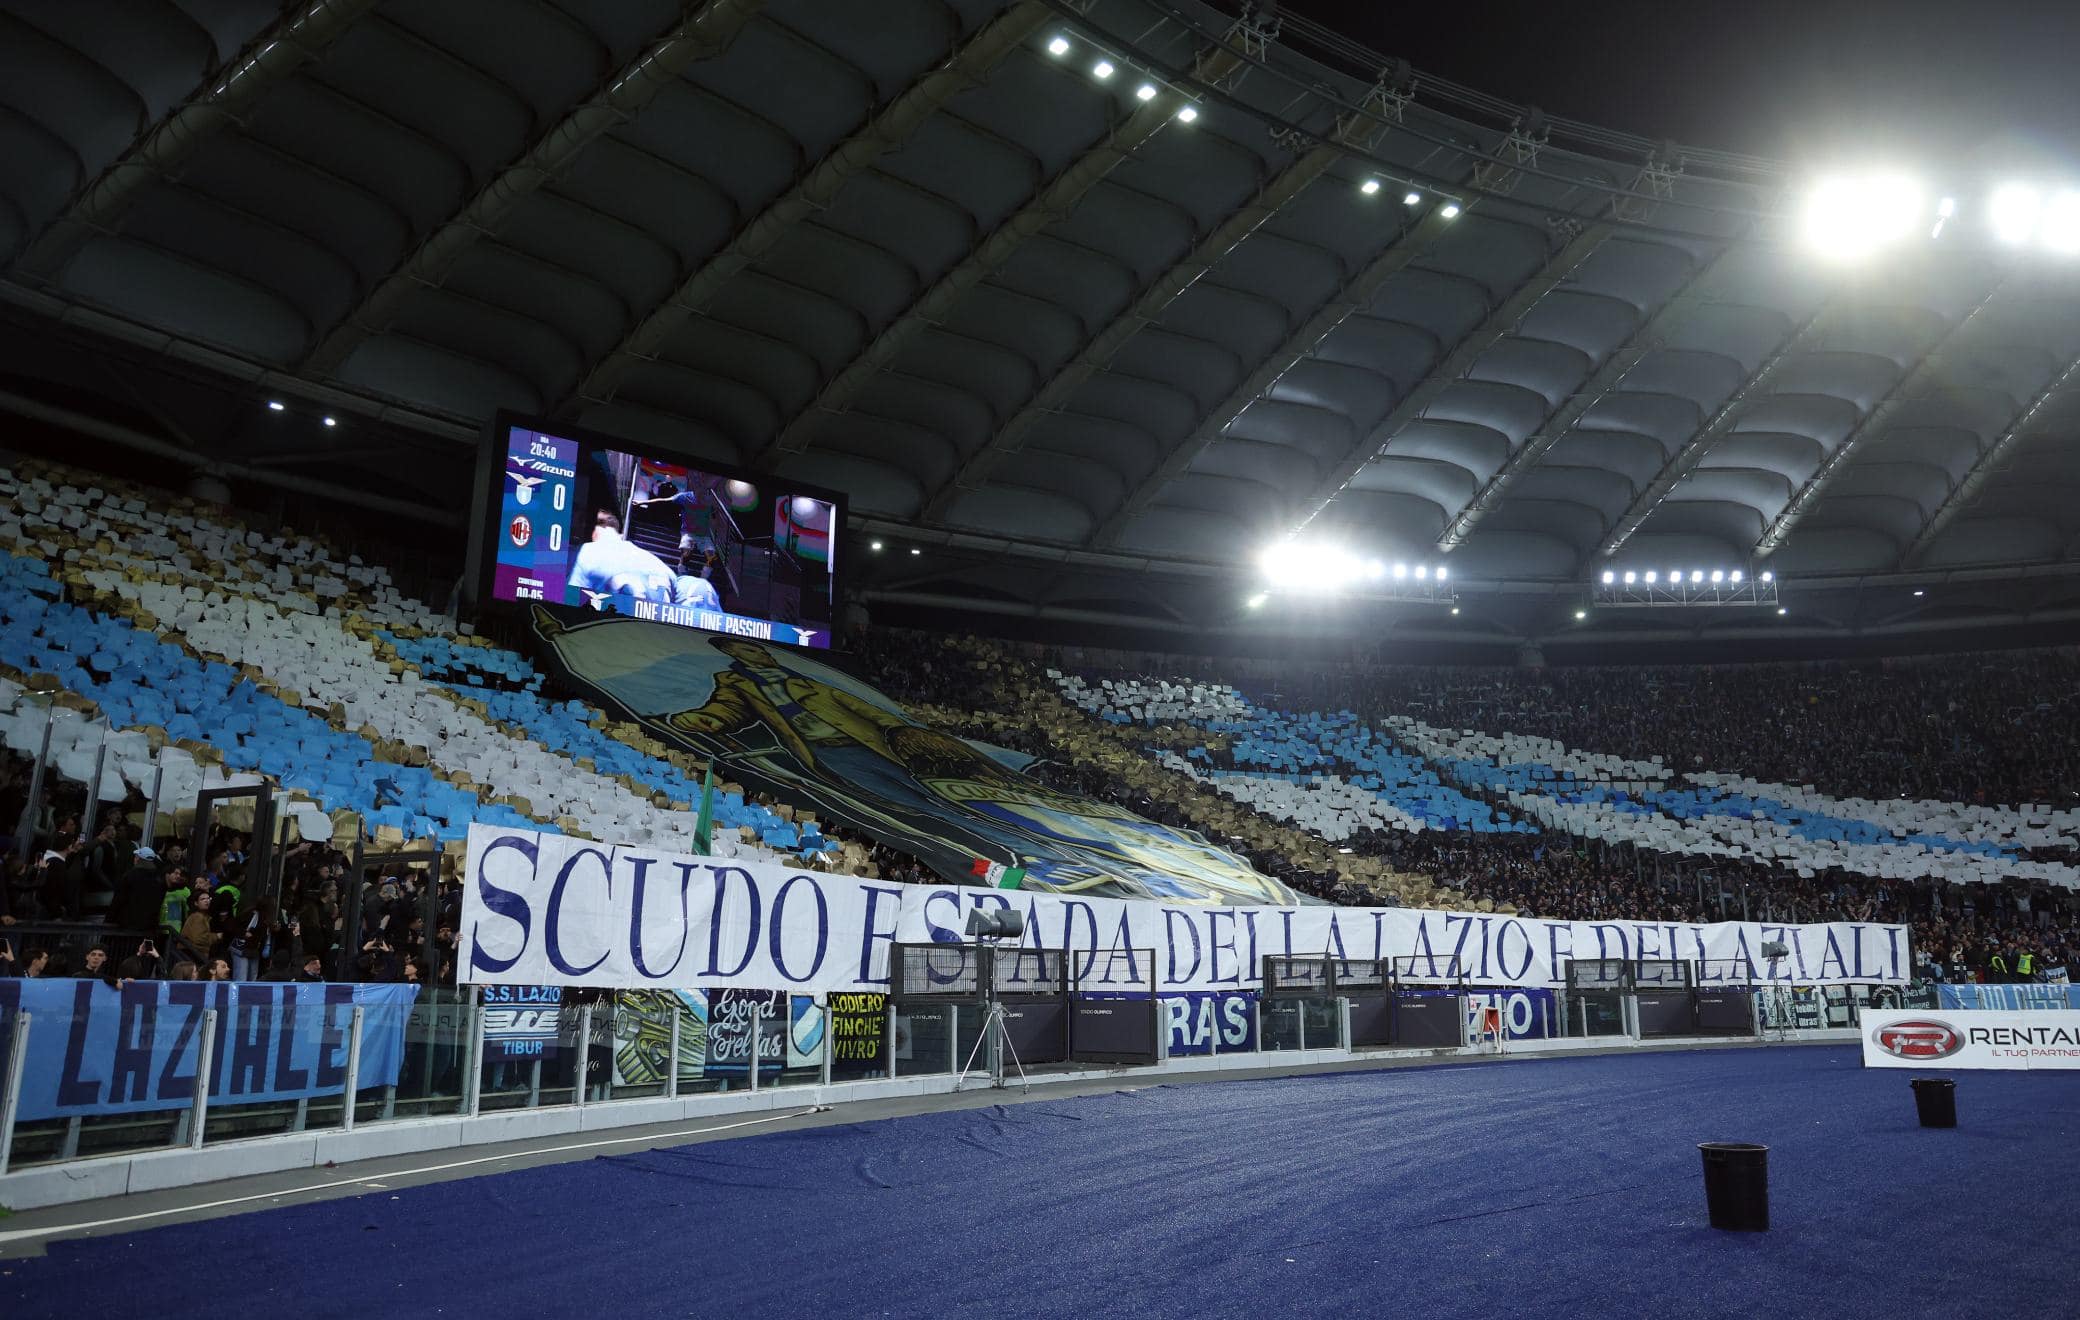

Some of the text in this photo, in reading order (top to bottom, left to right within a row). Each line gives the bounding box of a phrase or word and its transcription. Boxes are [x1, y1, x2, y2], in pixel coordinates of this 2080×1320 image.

[530, 442, 557, 460] 20:40
[554, 483, 566, 511] 0
[549, 523, 562, 551] 0
[634, 600, 771, 641] ONE FAITH ONE PASSION
[469, 832, 829, 983] SCUDO
[852, 884, 904, 985] E
[1161, 907, 1354, 987] DELLA
[1369, 911, 1534, 984] LAZIO
[1543, 921, 1579, 984] E
[1690, 921, 1904, 985] LAZIALI
[484, 985, 561, 1002] S.S. LAZIO
[714, 988, 776, 1032] Good
[832, 1016, 884, 1036] FINCHE'
[56, 980, 354, 1106] LAZIALE
[502, 1040, 543, 1055] TIBUR
[709, 1021, 782, 1062] Felas
[833, 1039, 880, 1059] VIVRO'
[1992, 1048, 2080, 1057] IL TUO PARTNE
